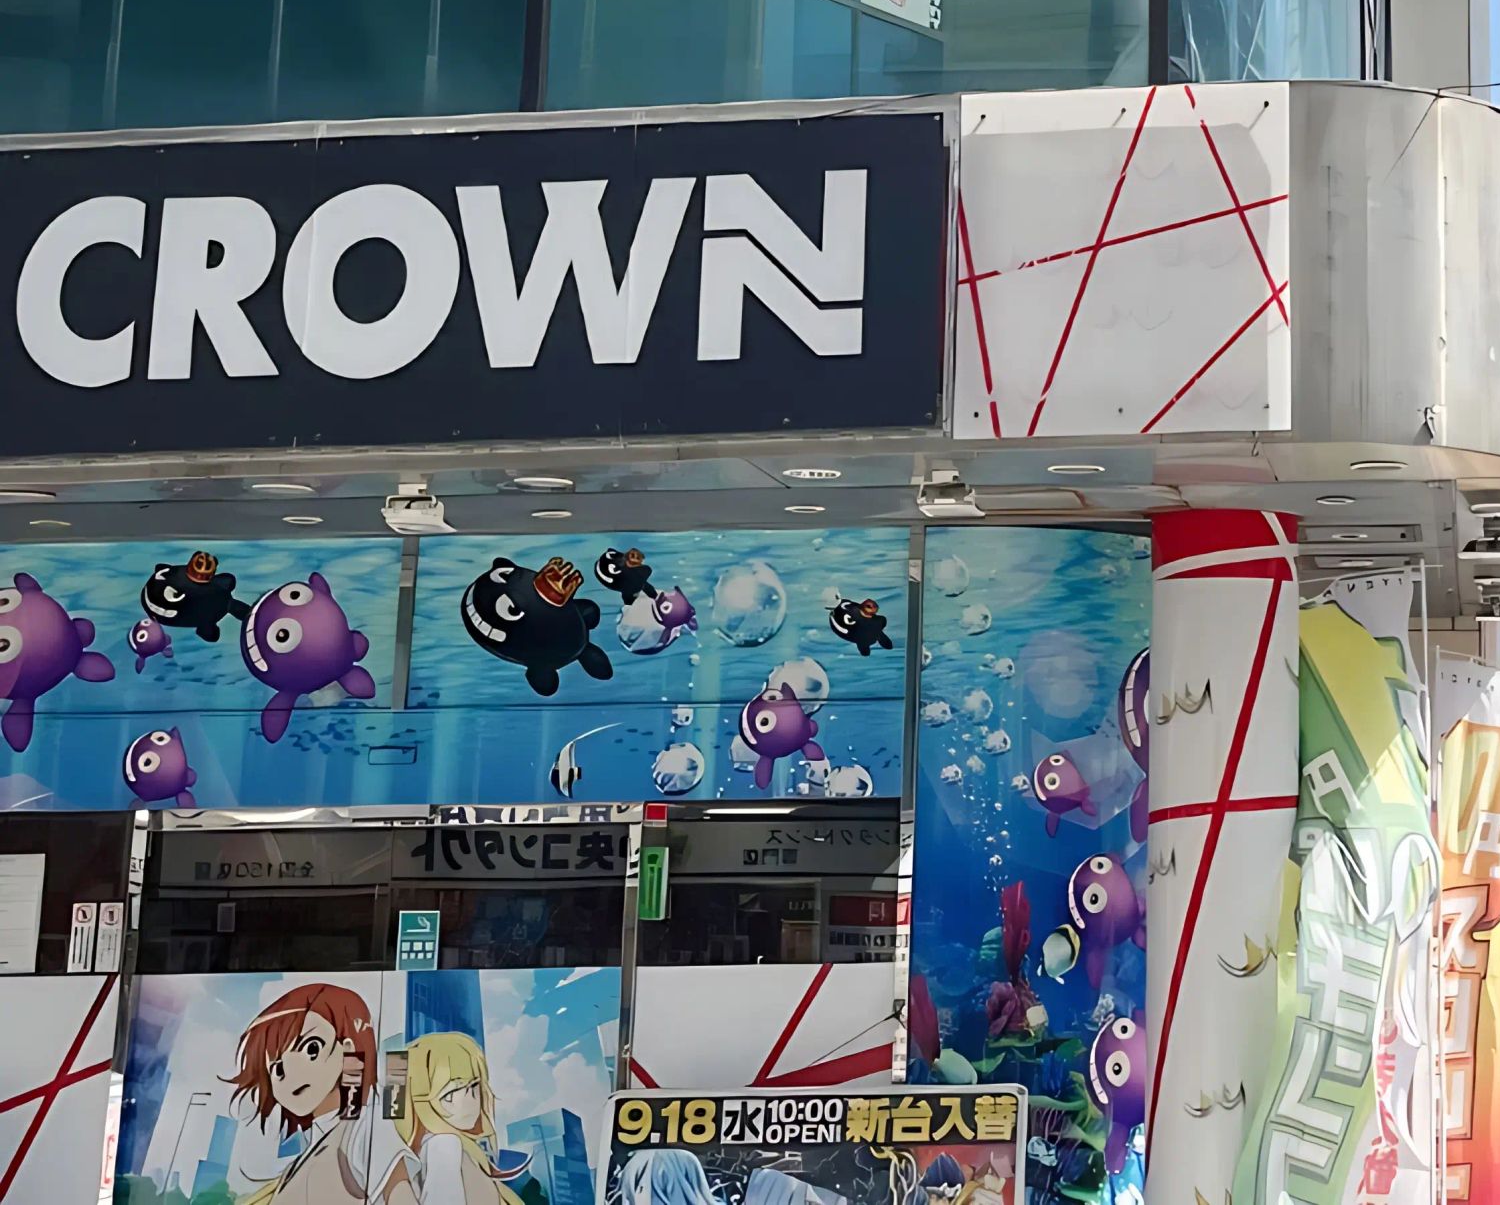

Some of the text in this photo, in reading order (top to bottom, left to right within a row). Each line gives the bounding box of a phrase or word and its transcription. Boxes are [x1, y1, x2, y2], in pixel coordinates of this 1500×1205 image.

[16, 169, 868, 388] CROWN
[617, 1098, 843, 1144] 9.18 水 10:00
[845, 1097, 1018, 1144] 新台入替
